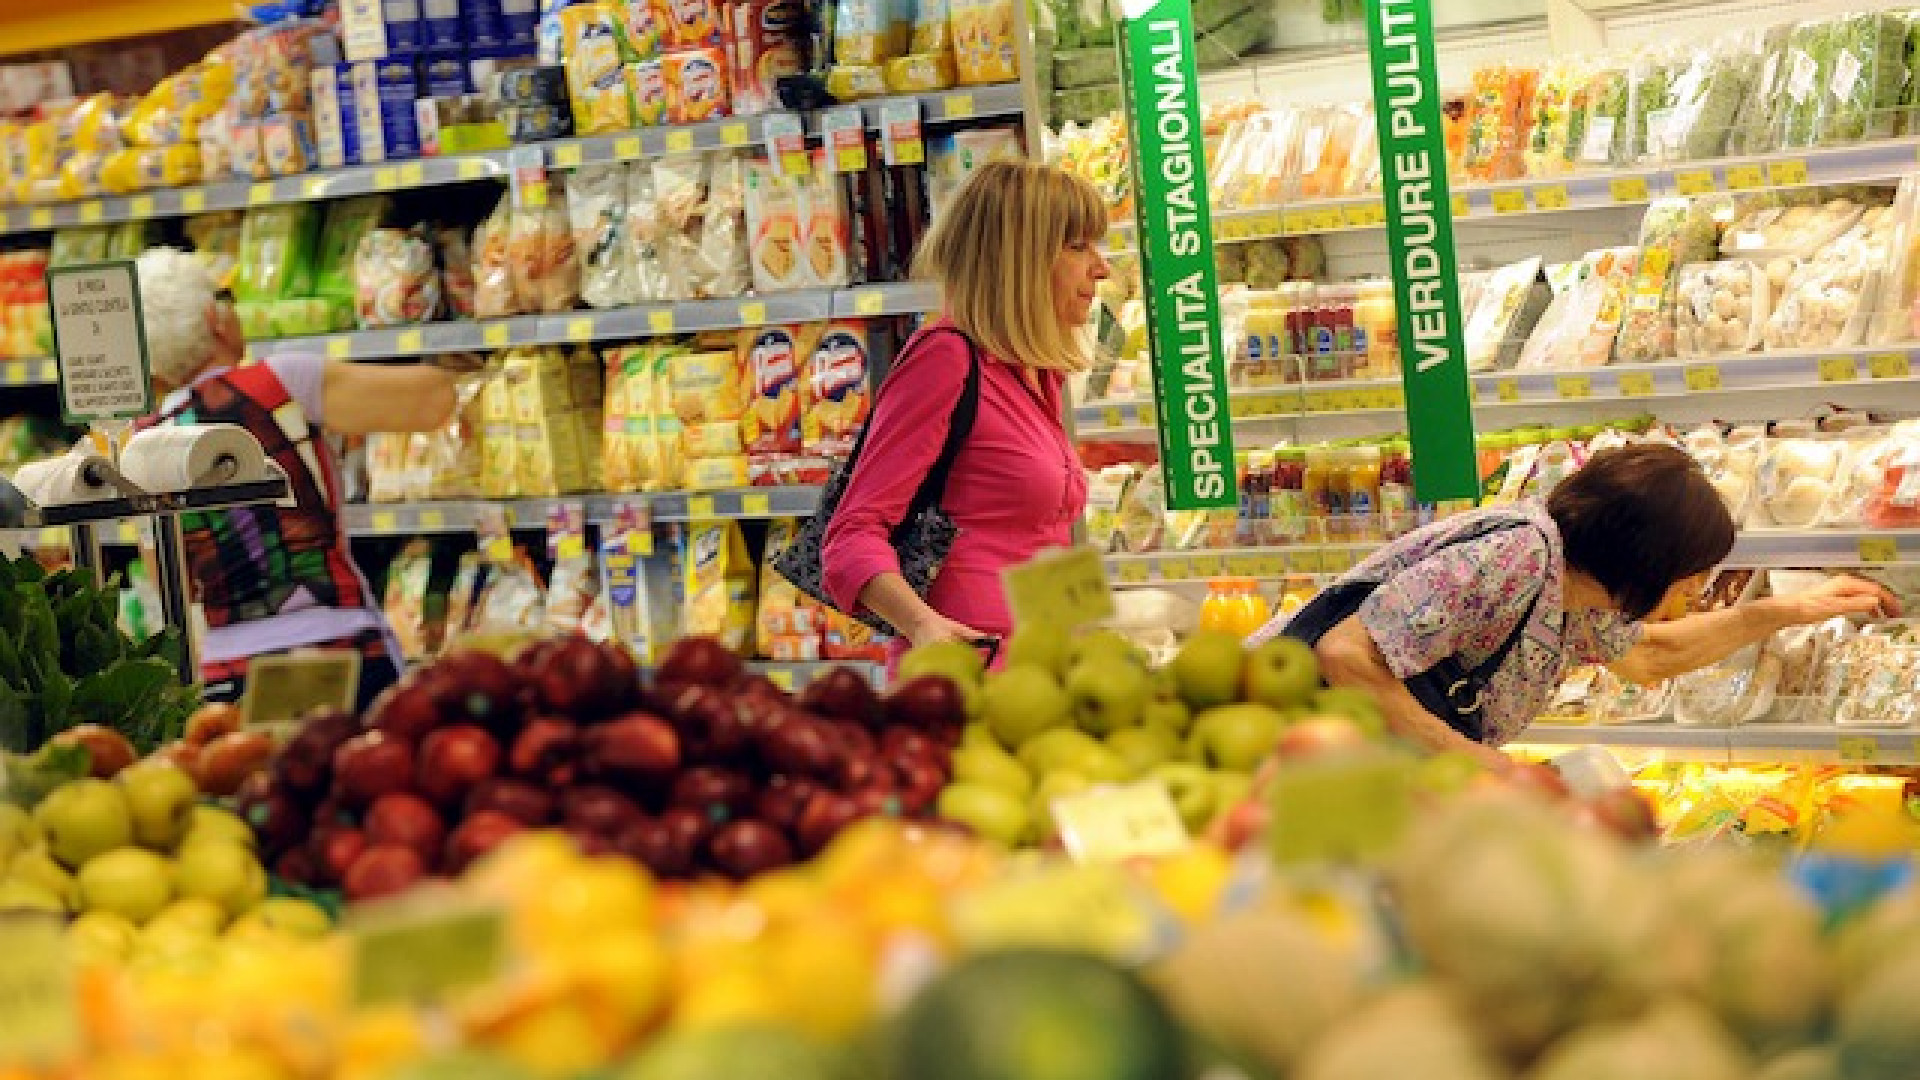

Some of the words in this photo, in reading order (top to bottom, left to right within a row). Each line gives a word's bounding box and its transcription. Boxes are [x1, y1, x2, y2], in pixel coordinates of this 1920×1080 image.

[1149, 20, 1200, 256] STAGIONALI
[1380, 0, 1425, 138] PULIT
[1395, 150, 1449, 372] VERDURE
[1167, 269, 1224, 498] SPECIALITÀ
